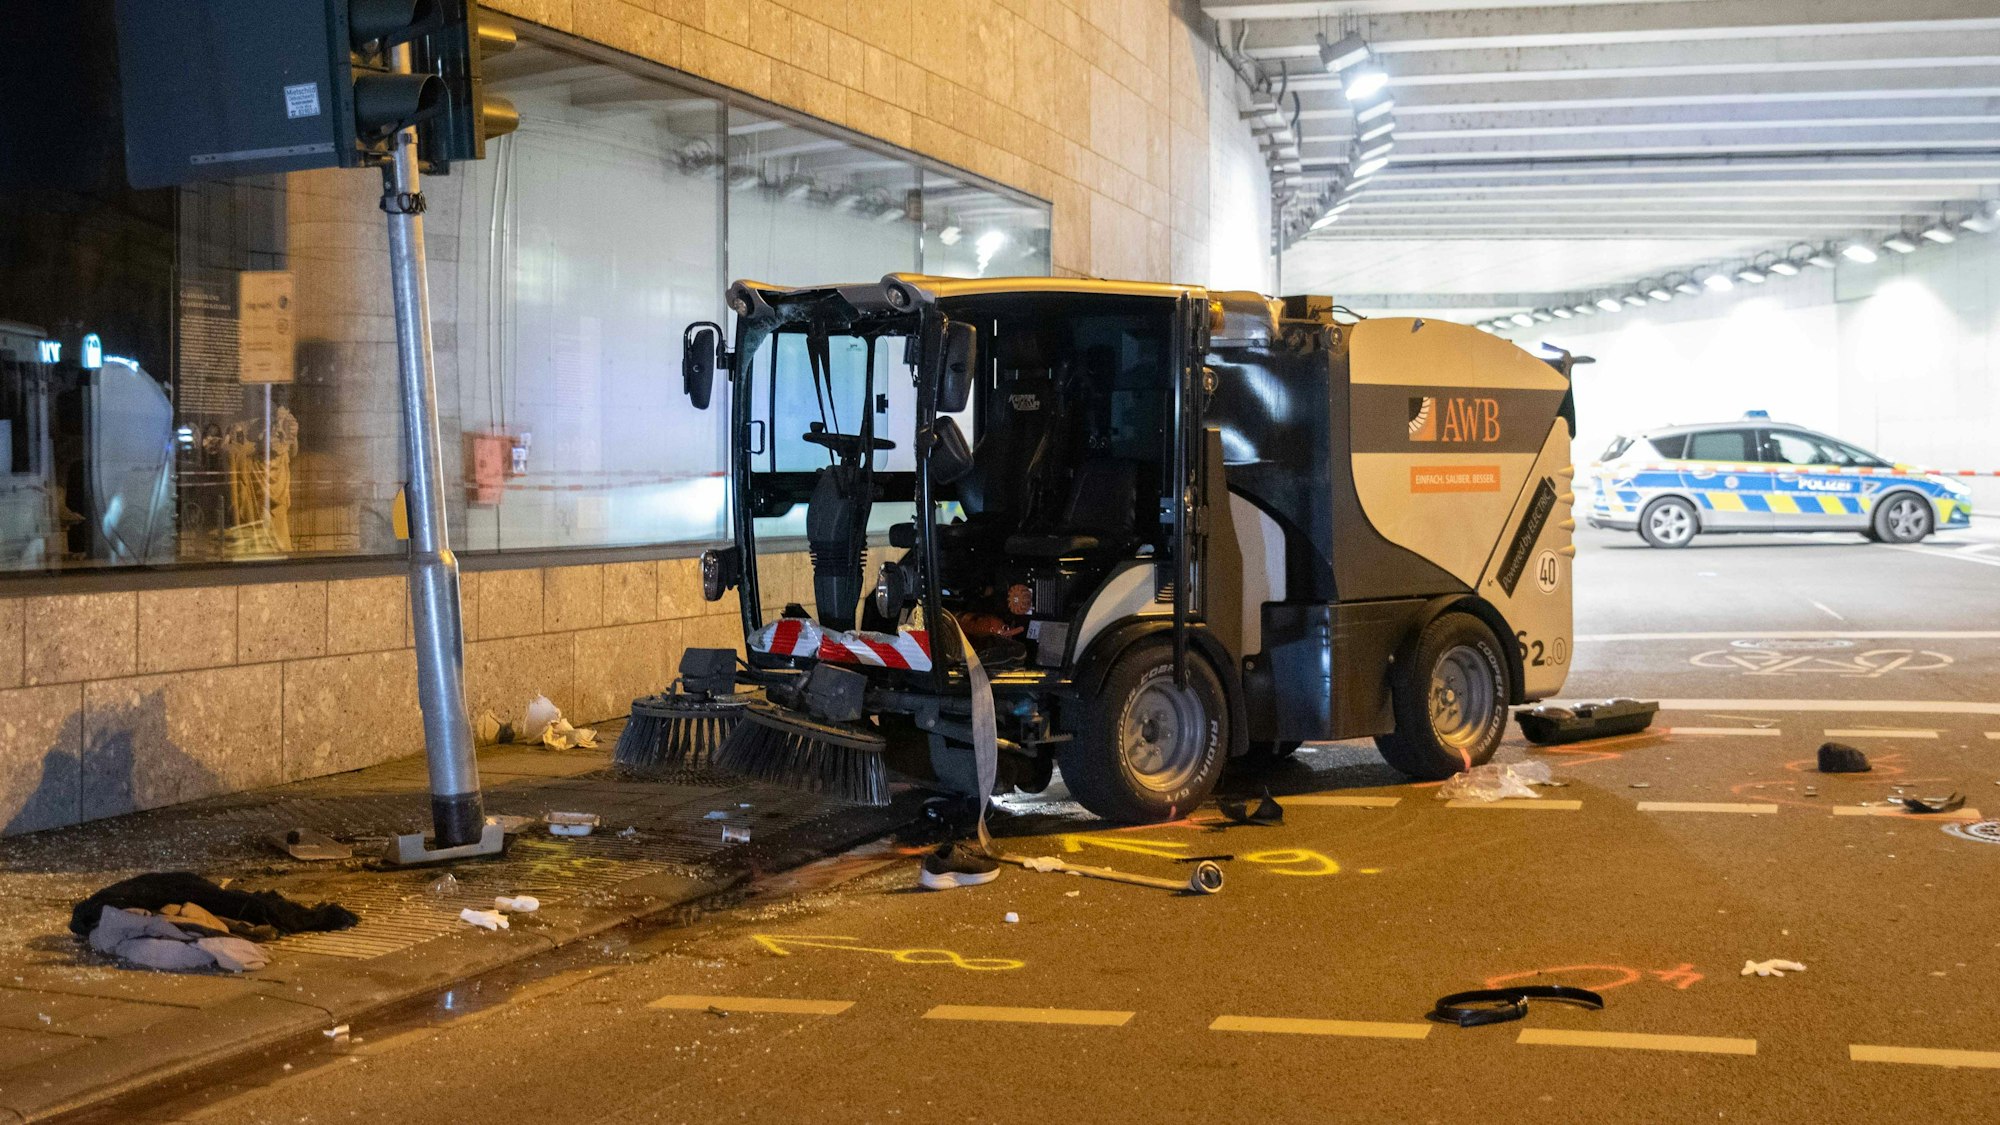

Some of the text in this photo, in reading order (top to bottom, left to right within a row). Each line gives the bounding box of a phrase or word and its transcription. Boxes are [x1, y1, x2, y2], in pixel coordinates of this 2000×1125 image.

[1441, 398, 1500, 442] AWB
[1415, 473, 1496, 485] EINFACH. SAUBER. BESSER.
[1798, 478, 1851, 491] POLIZEI
[1502, 487, 1552, 590] Powered by ELECTRIC
[1540, 557, 1556, 585] 40
[1477, 640, 1504, 753] COOPER COBRA
[1194, 719, 1219, 784] RADIAL
